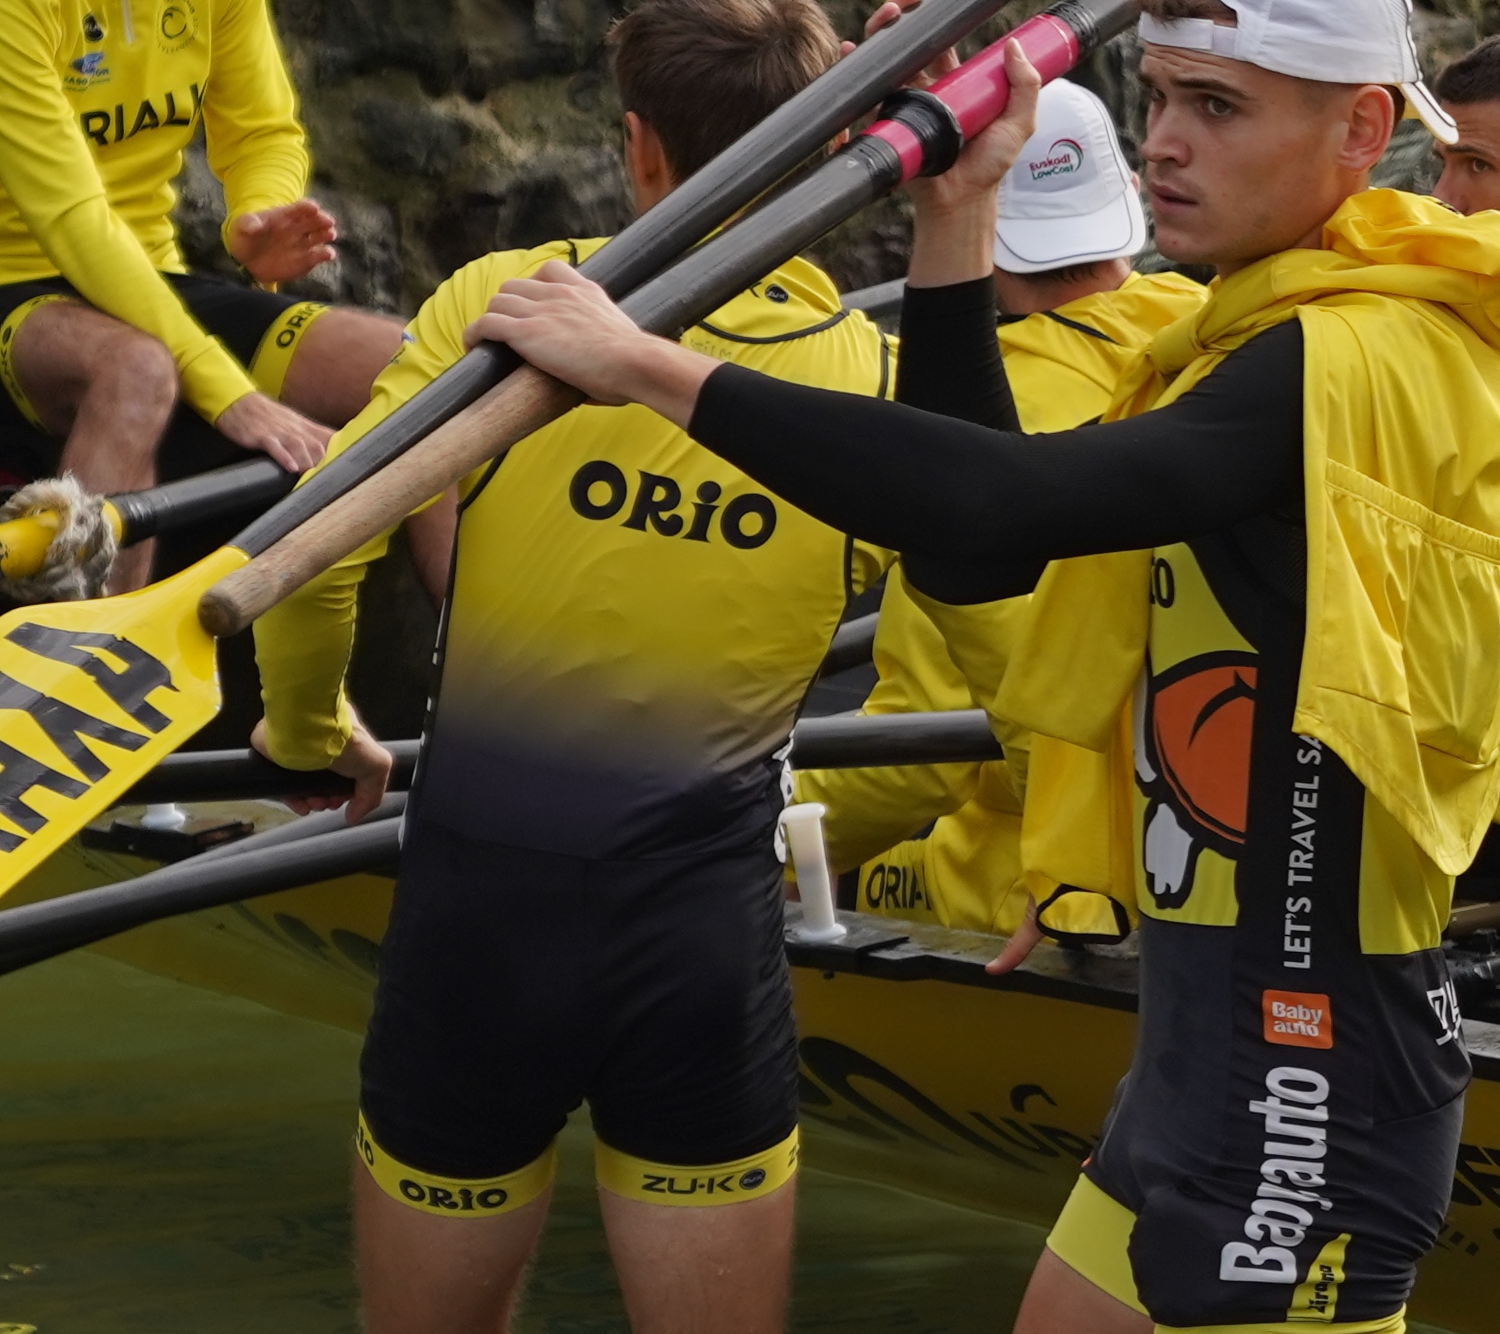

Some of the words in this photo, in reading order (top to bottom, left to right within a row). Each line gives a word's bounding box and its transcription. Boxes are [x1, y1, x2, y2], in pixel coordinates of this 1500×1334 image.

[1029, 154, 1072, 171] Euskadi
[1288, 775, 1320, 887] TRAVEL
[1283, 887, 1313, 970] LET'S
[1271, 1001, 1323, 1024] Baby
[1274, 1021, 1320, 1038] auto
